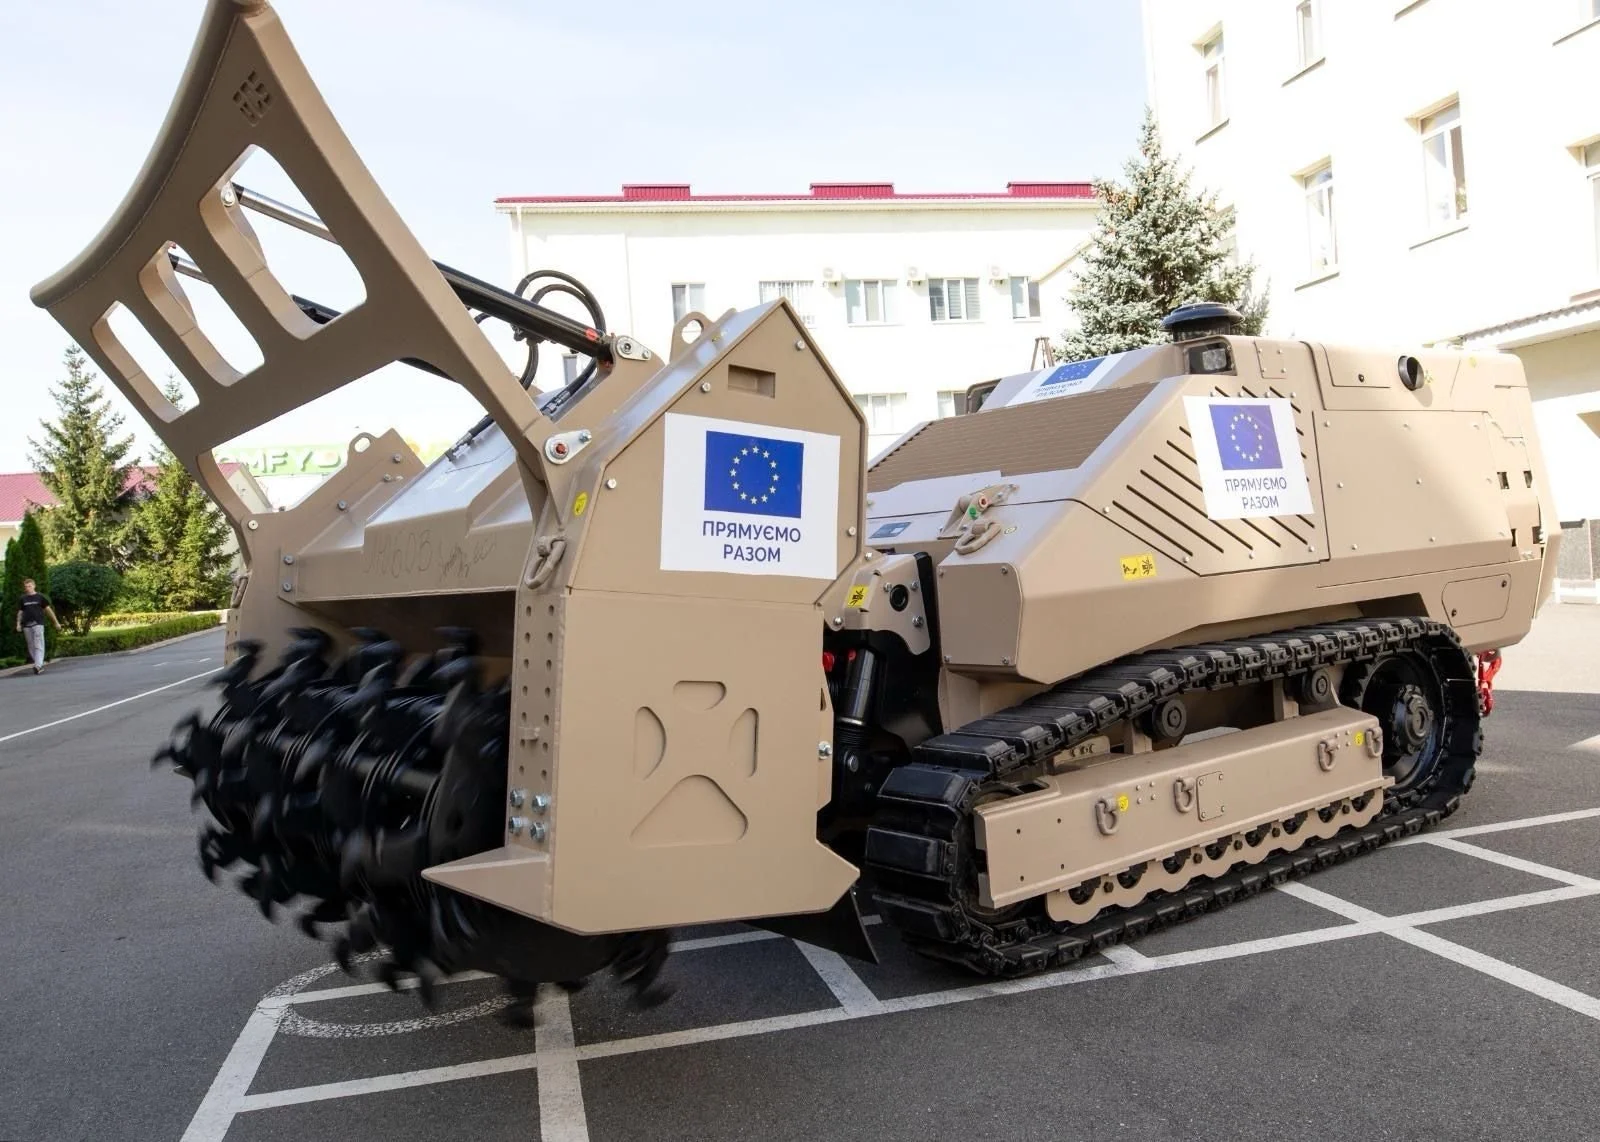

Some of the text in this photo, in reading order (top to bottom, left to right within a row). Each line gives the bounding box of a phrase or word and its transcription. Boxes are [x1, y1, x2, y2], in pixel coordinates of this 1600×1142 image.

[1224, 477, 1288, 493] ПРЯМУЄМО
[1241, 496, 1280, 509] РАЗОМ
[702, 520, 801, 542] ПРЯМУЄМО
[723, 544, 781, 562] РАЗОМ
